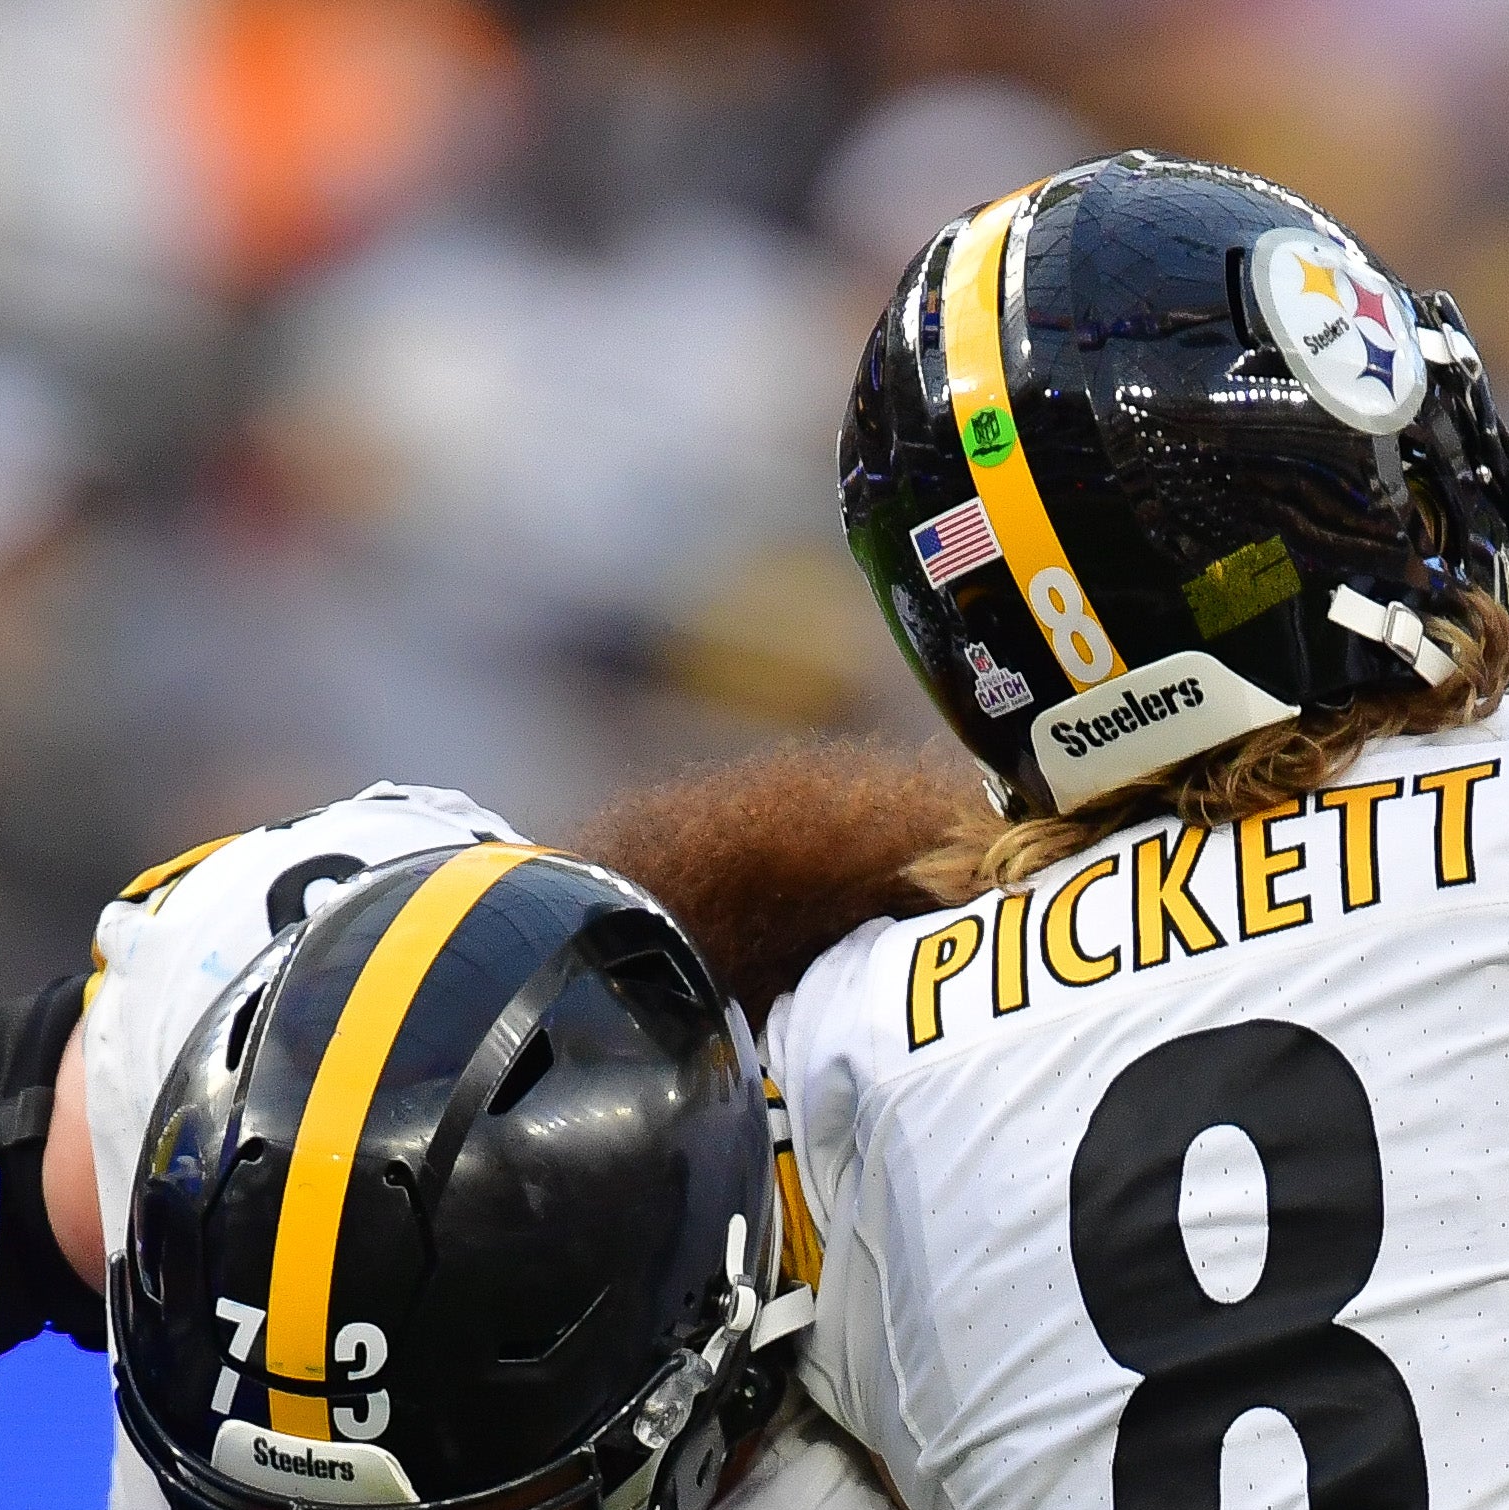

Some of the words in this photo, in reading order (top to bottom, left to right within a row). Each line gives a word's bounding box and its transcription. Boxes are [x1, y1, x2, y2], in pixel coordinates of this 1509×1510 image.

[1302, 316, 1351, 356] Steelers
[1028, 566, 1114, 684] 8
[977, 674, 1028, 709] CATCH
[1050, 677, 1205, 758] Steelers
[906, 758, 1502, 1051] PICKETT
[210, 1297, 391, 1441] 73
[253, 1437, 356, 1483] Steelers
